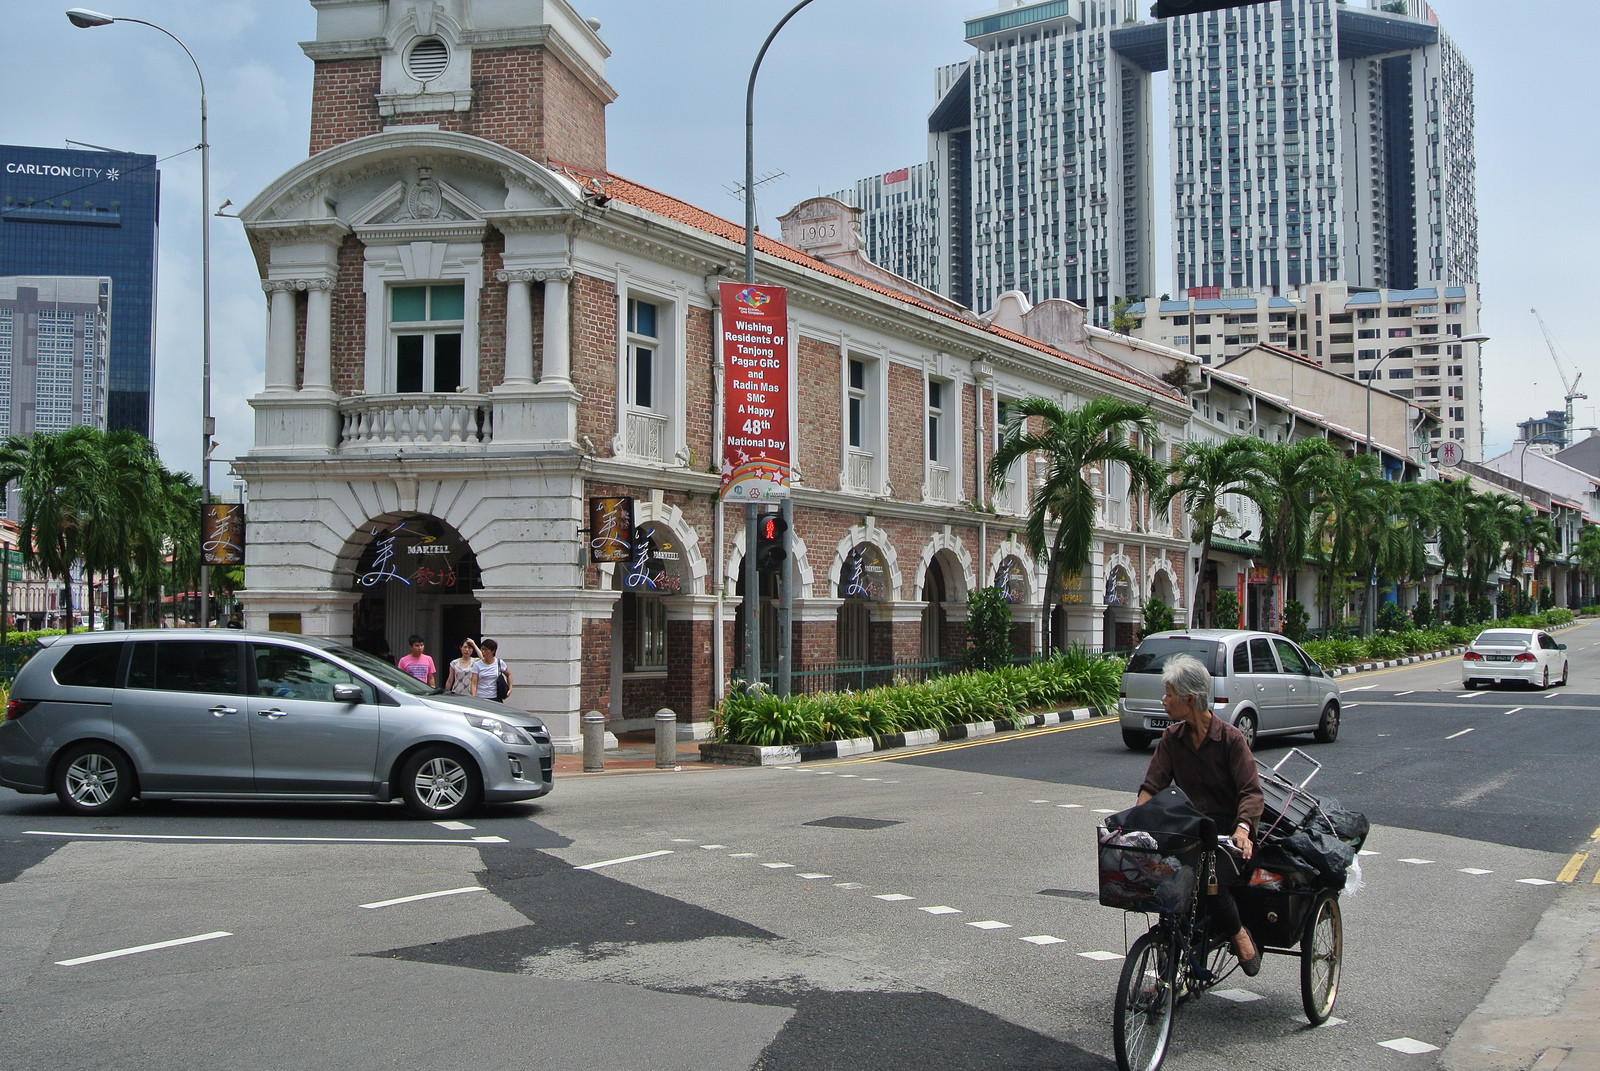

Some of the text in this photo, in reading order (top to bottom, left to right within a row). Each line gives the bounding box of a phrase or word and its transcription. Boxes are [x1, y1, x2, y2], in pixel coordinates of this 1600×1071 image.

[6, 162, 102, 178] CARLTON CITY
[802, 224, 836, 240] 1903
[736, 321, 772, 334] Wishing
[725, 332, 784, 345] Residents Of
[737, 344, 774, 358] Tanjong
[731, 356, 780, 368] Pagar GRC
[733, 380, 779, 392] Radin Mas
[747, 393, 766, 403] SMC
[738, 404, 775, 418] A Happy
[742, 419, 770, 435] 48th
[727, 436, 786, 450] National Day
[408, 545, 450, 554] MARTELL
